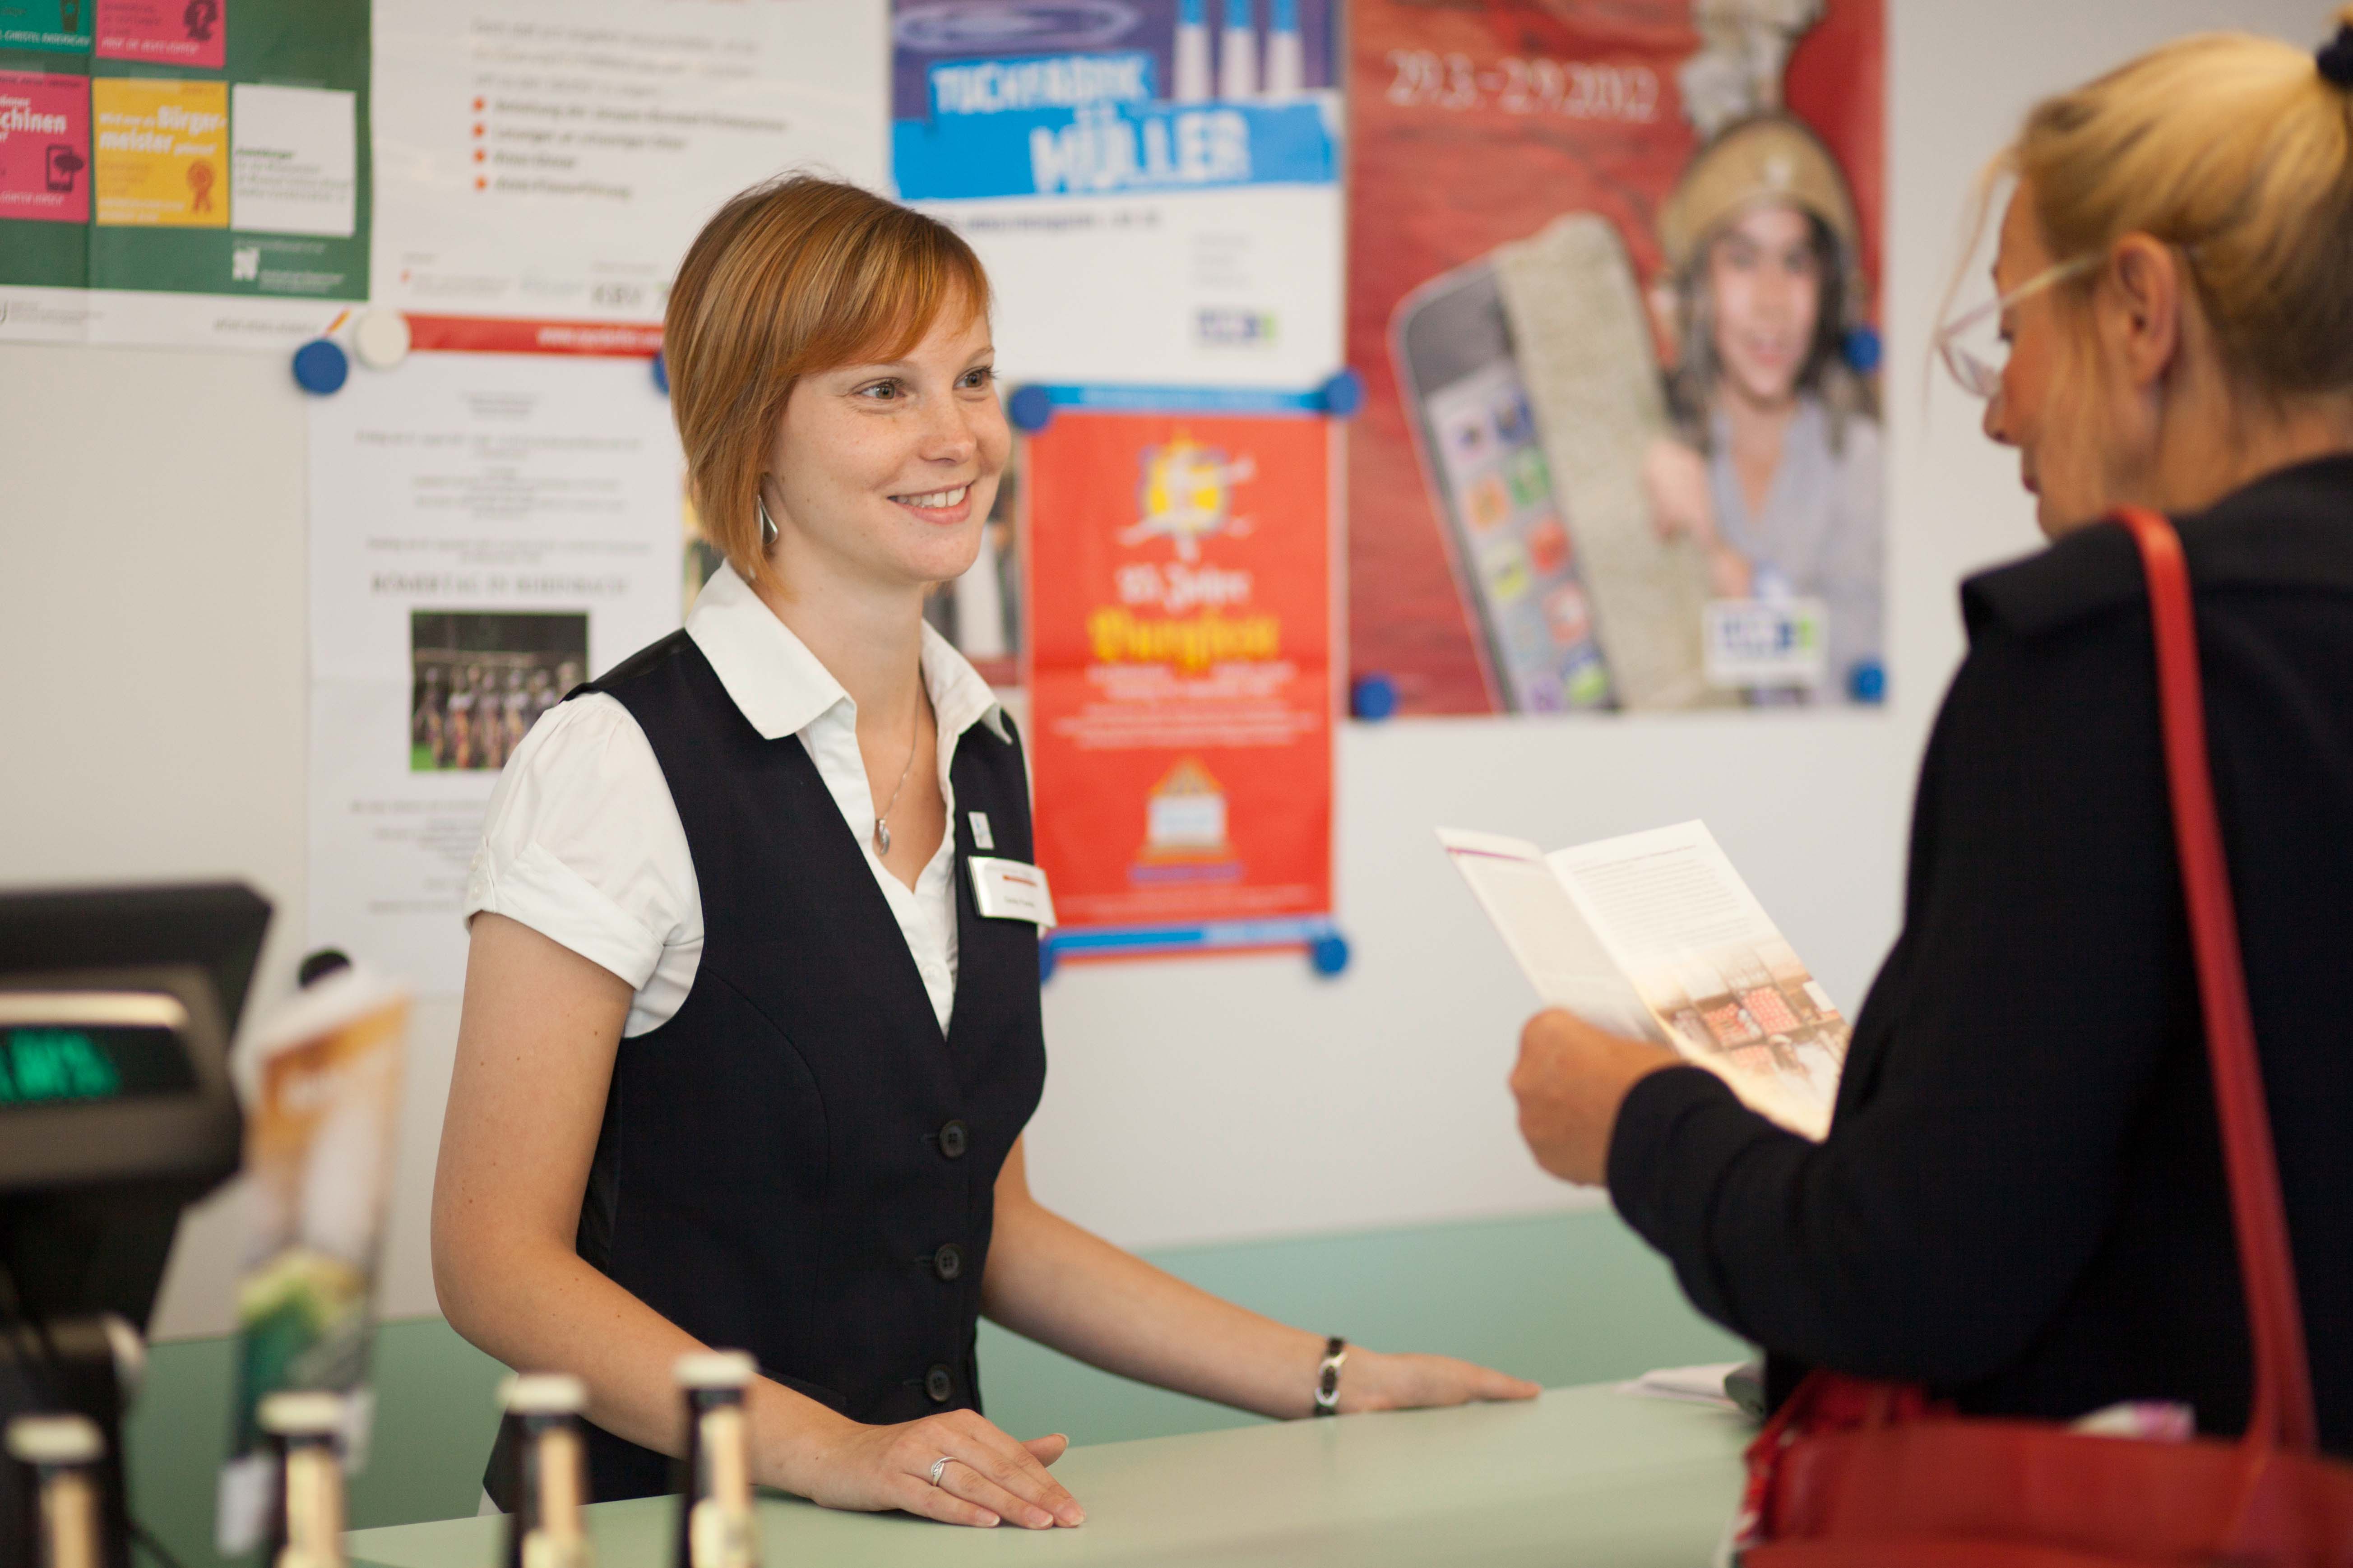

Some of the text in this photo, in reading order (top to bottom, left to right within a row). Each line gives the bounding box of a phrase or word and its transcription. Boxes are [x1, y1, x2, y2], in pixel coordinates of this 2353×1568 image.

[931, 53, 1147, 114] TUCHFABRIK
[99, 129, 174, 153] meister
[1029, 103, 1252, 196] MÜLLER
